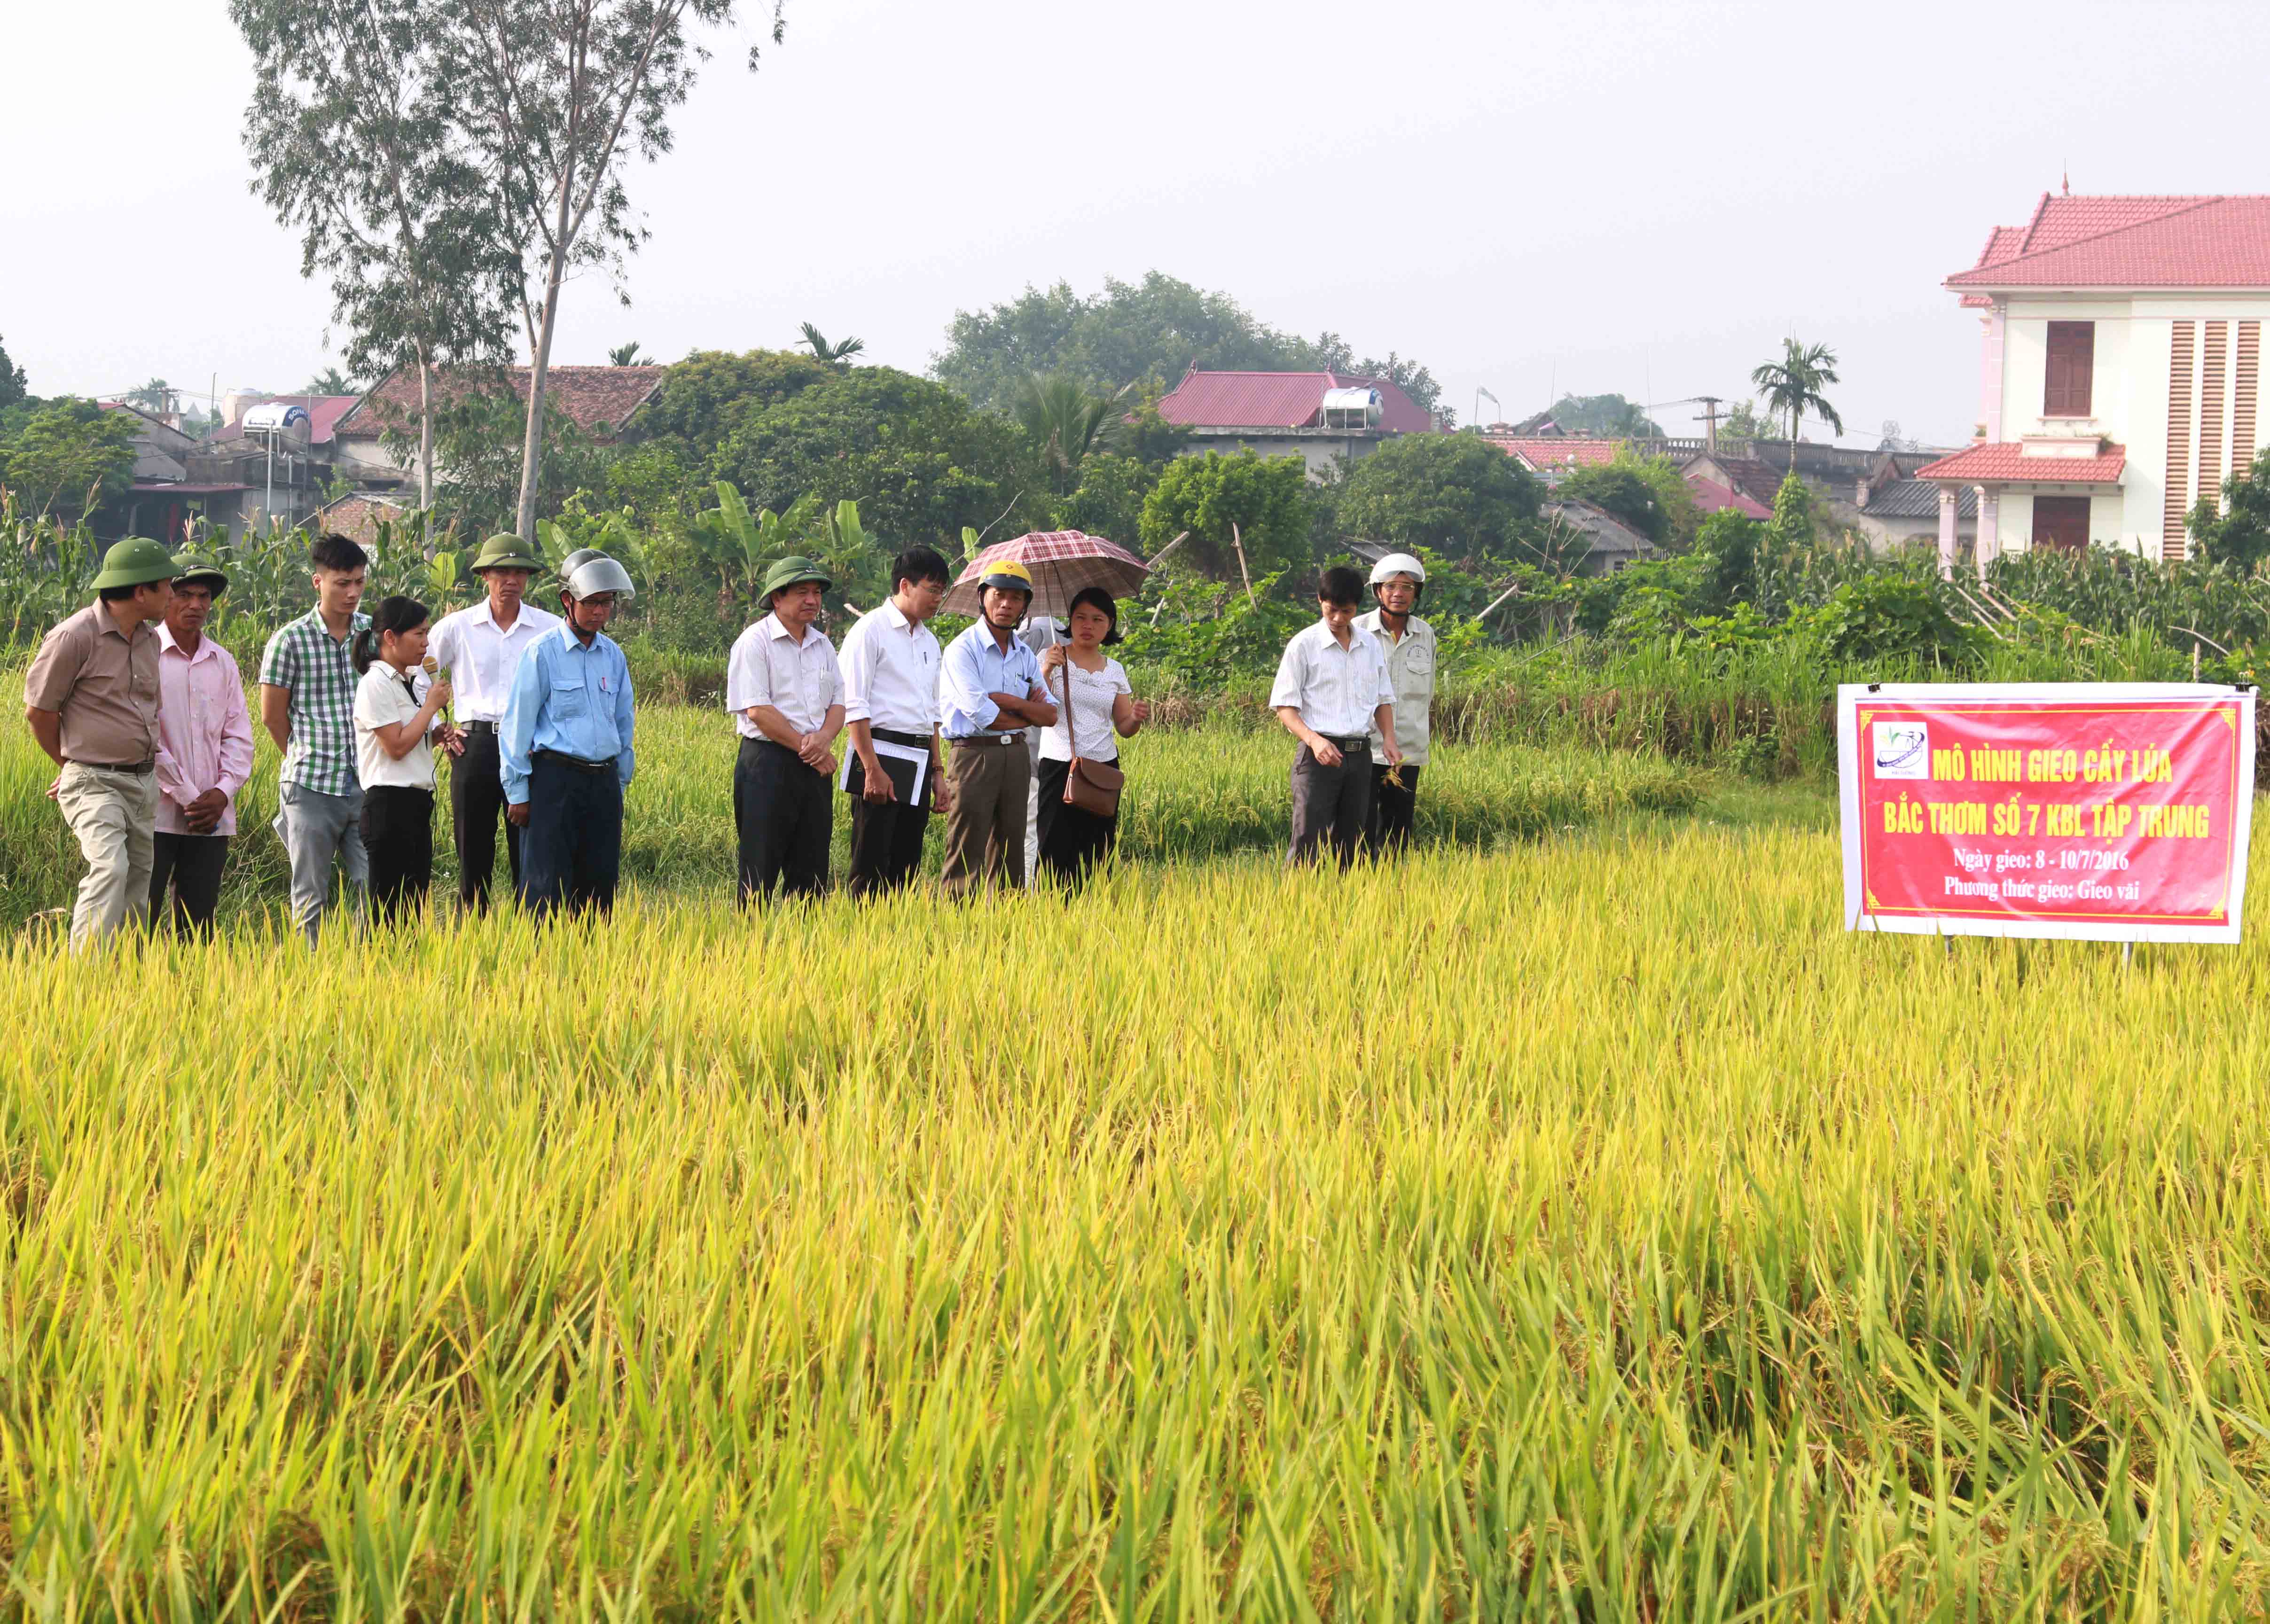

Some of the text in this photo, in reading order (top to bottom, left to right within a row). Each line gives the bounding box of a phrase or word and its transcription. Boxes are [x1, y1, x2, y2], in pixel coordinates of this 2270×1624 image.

[1933, 742, 1965, 781] MÔ
[1970, 742, 2021, 782] HÌNH
[2028, 749, 2077, 782] GIEO
[2083, 738, 2126, 782] CẤY
[2132, 742, 2173, 783] LÚA
[1884, 791, 2210, 845] BẮC THƠM SỐ 7 KBL TẬP TRUNG
[1953, 848, 1992, 873] Ngày
[1996, 849, 2031, 873] gieo:
[2035, 850, 2045, 869] 8
[2060, 849, 2129, 870] 10/7/2016
[1944, 876, 1998, 901] Phương
[2002, 878, 2035, 898] thức
[2037, 879, 2074, 903] gieo:
[2077, 880, 2113, 899] Gieo
